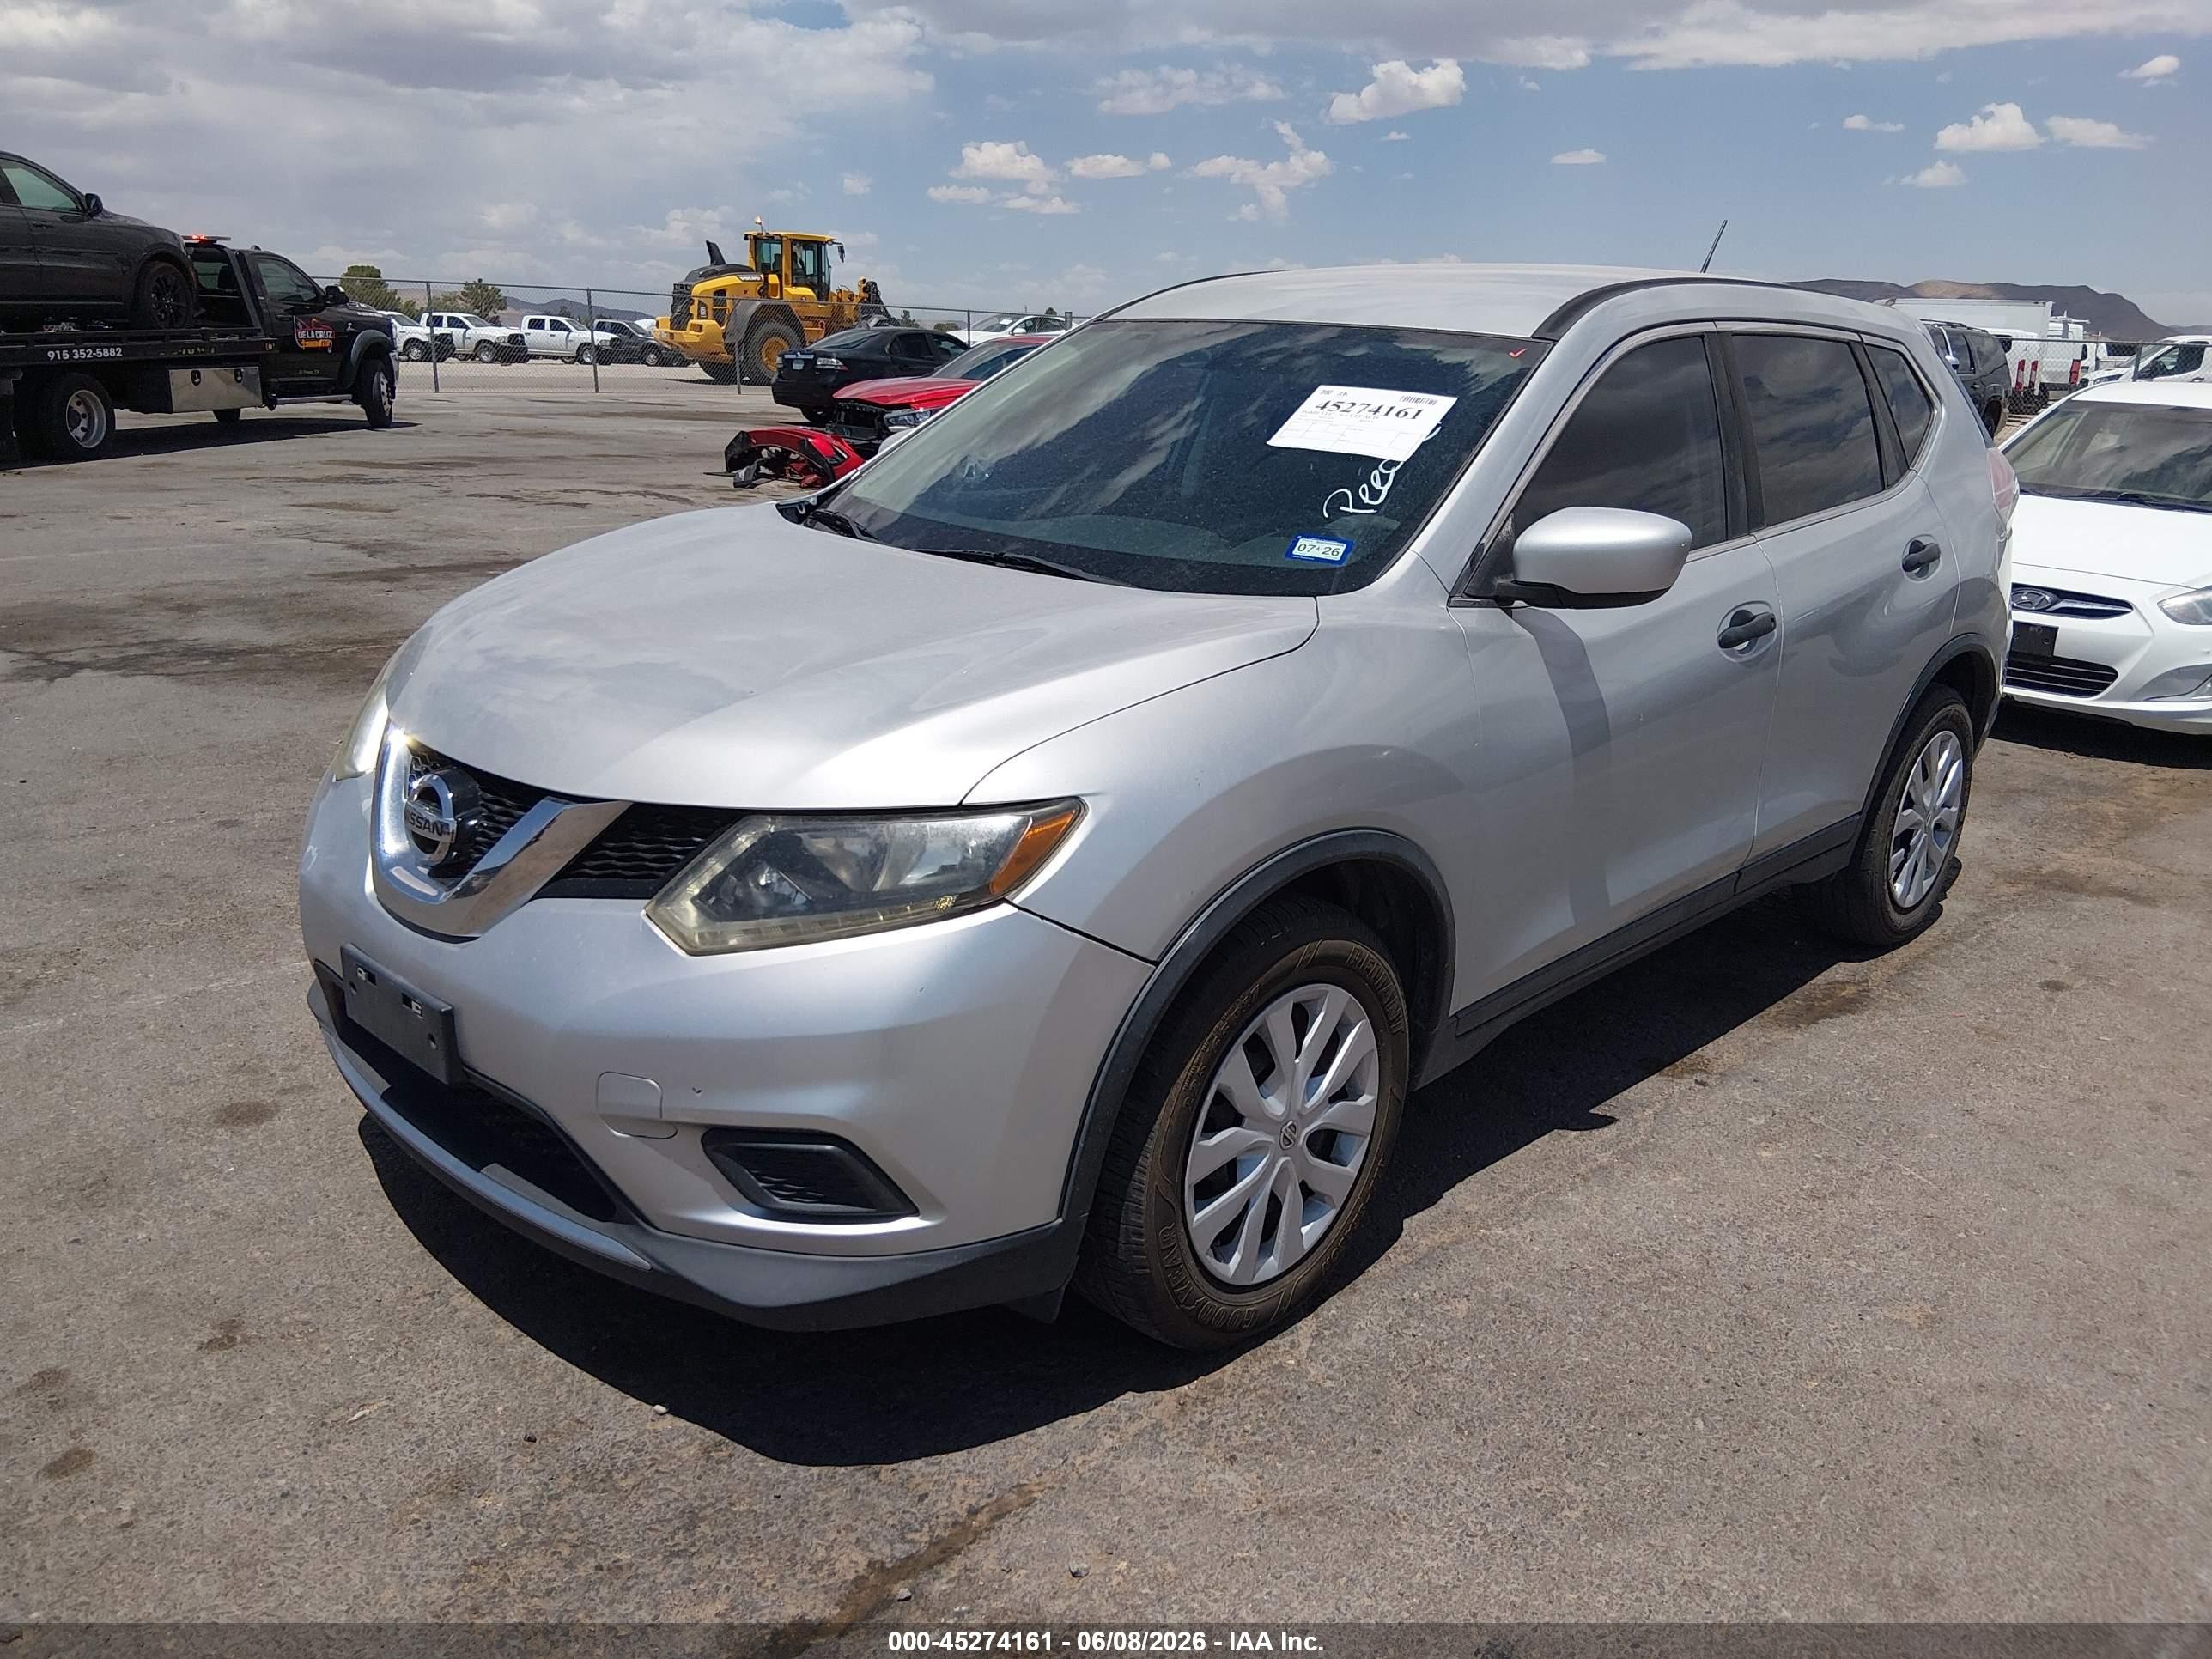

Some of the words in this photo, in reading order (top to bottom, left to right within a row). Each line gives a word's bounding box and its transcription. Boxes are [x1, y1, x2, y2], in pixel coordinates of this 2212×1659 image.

[307, 330, 315, 338] LA
[315, 330, 333, 338] CRUZ
[47, 350, 70, 361] 915
[72, 347, 123, 359] 352-5882
[1315, 400, 1424, 420] 45274161
